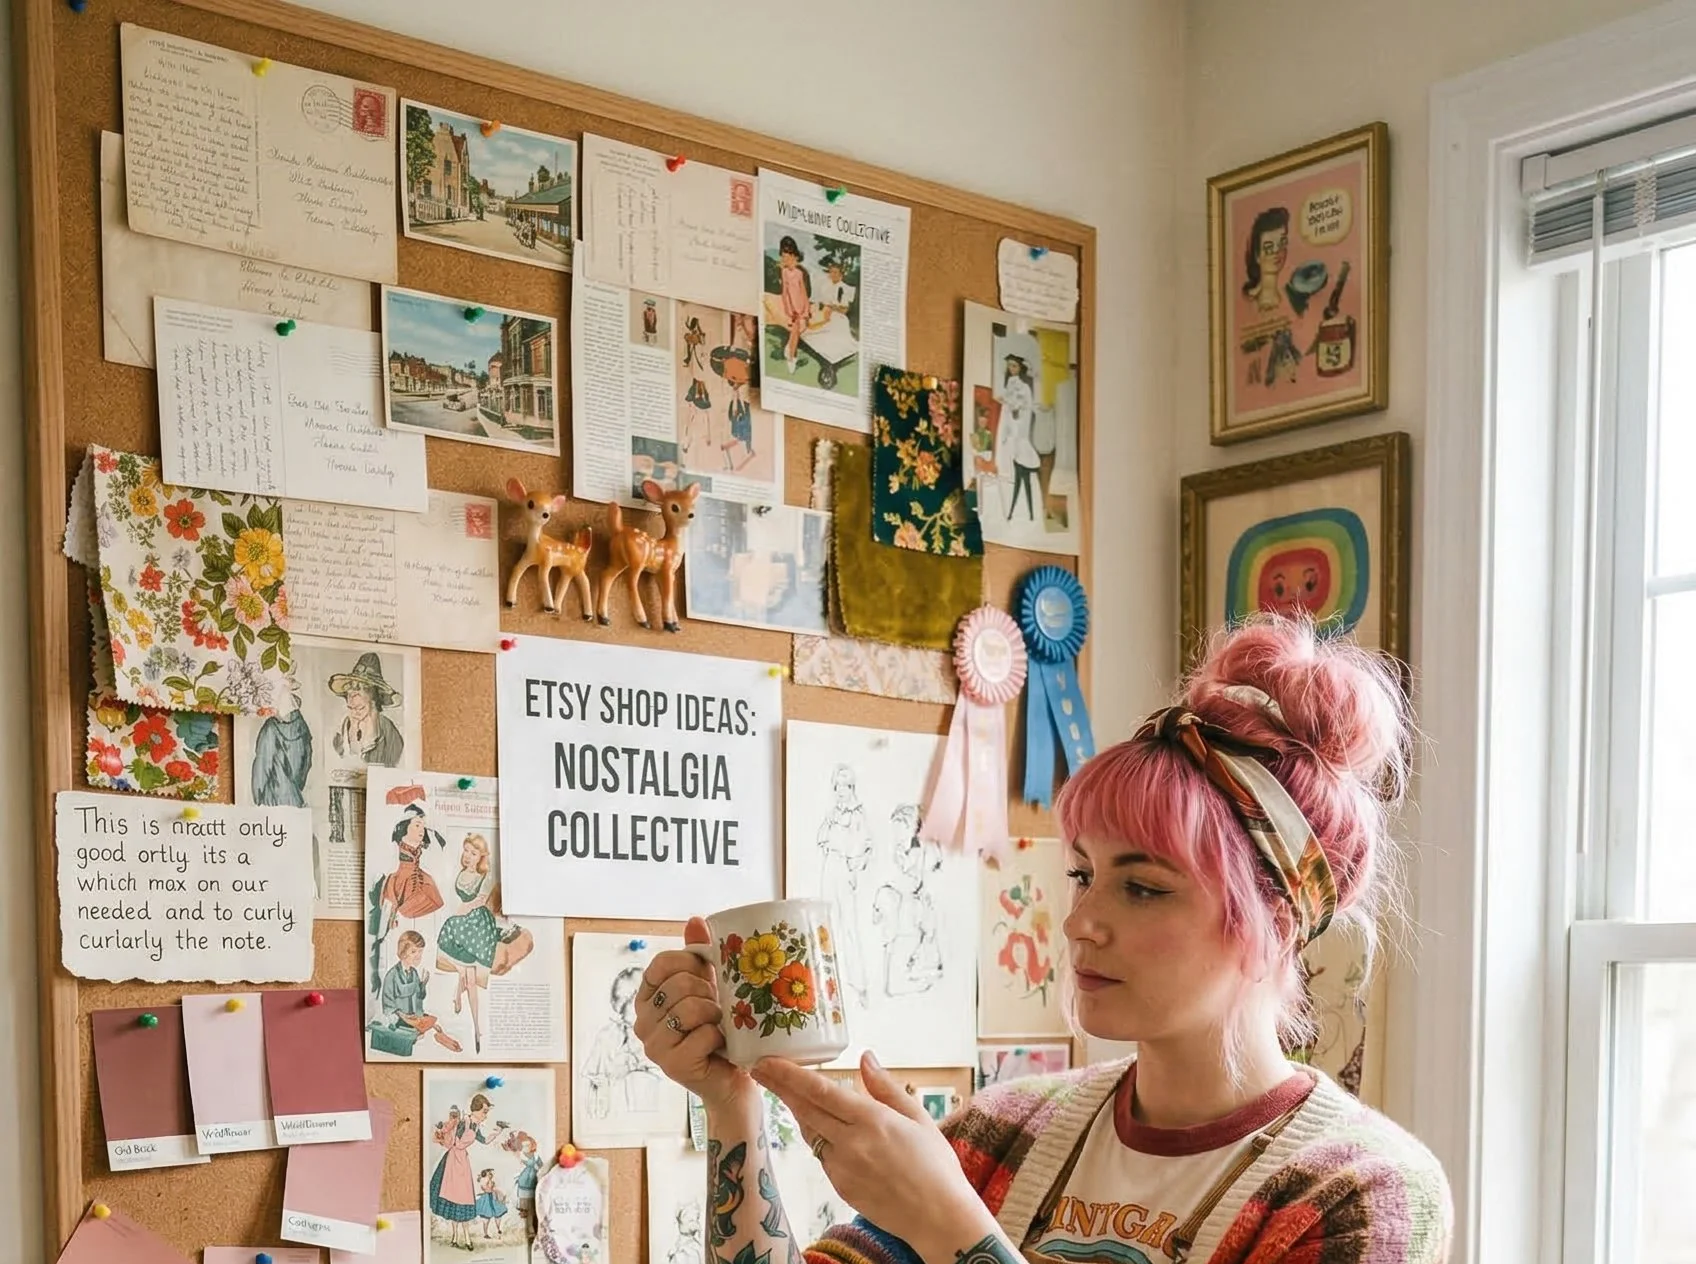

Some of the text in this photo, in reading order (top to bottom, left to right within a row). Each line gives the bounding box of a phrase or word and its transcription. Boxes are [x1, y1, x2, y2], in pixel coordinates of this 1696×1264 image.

[525, 678, 757, 737] ETSY SHOP IDEAS:
[554, 742, 731, 801] NOSTALGIA
[74, 806, 128, 835] This
[142, 814, 160, 835] is
[548, 809, 739, 866] COLLECTIVE
[77, 841, 250, 873] good ortly its a
[77, 871, 137, 891] which
[197, 878, 220, 892] on
[232, 878, 268, 892] our
[78, 900, 297, 932] needed and to curly
[79, 929, 271, 961] curlarly the note.
